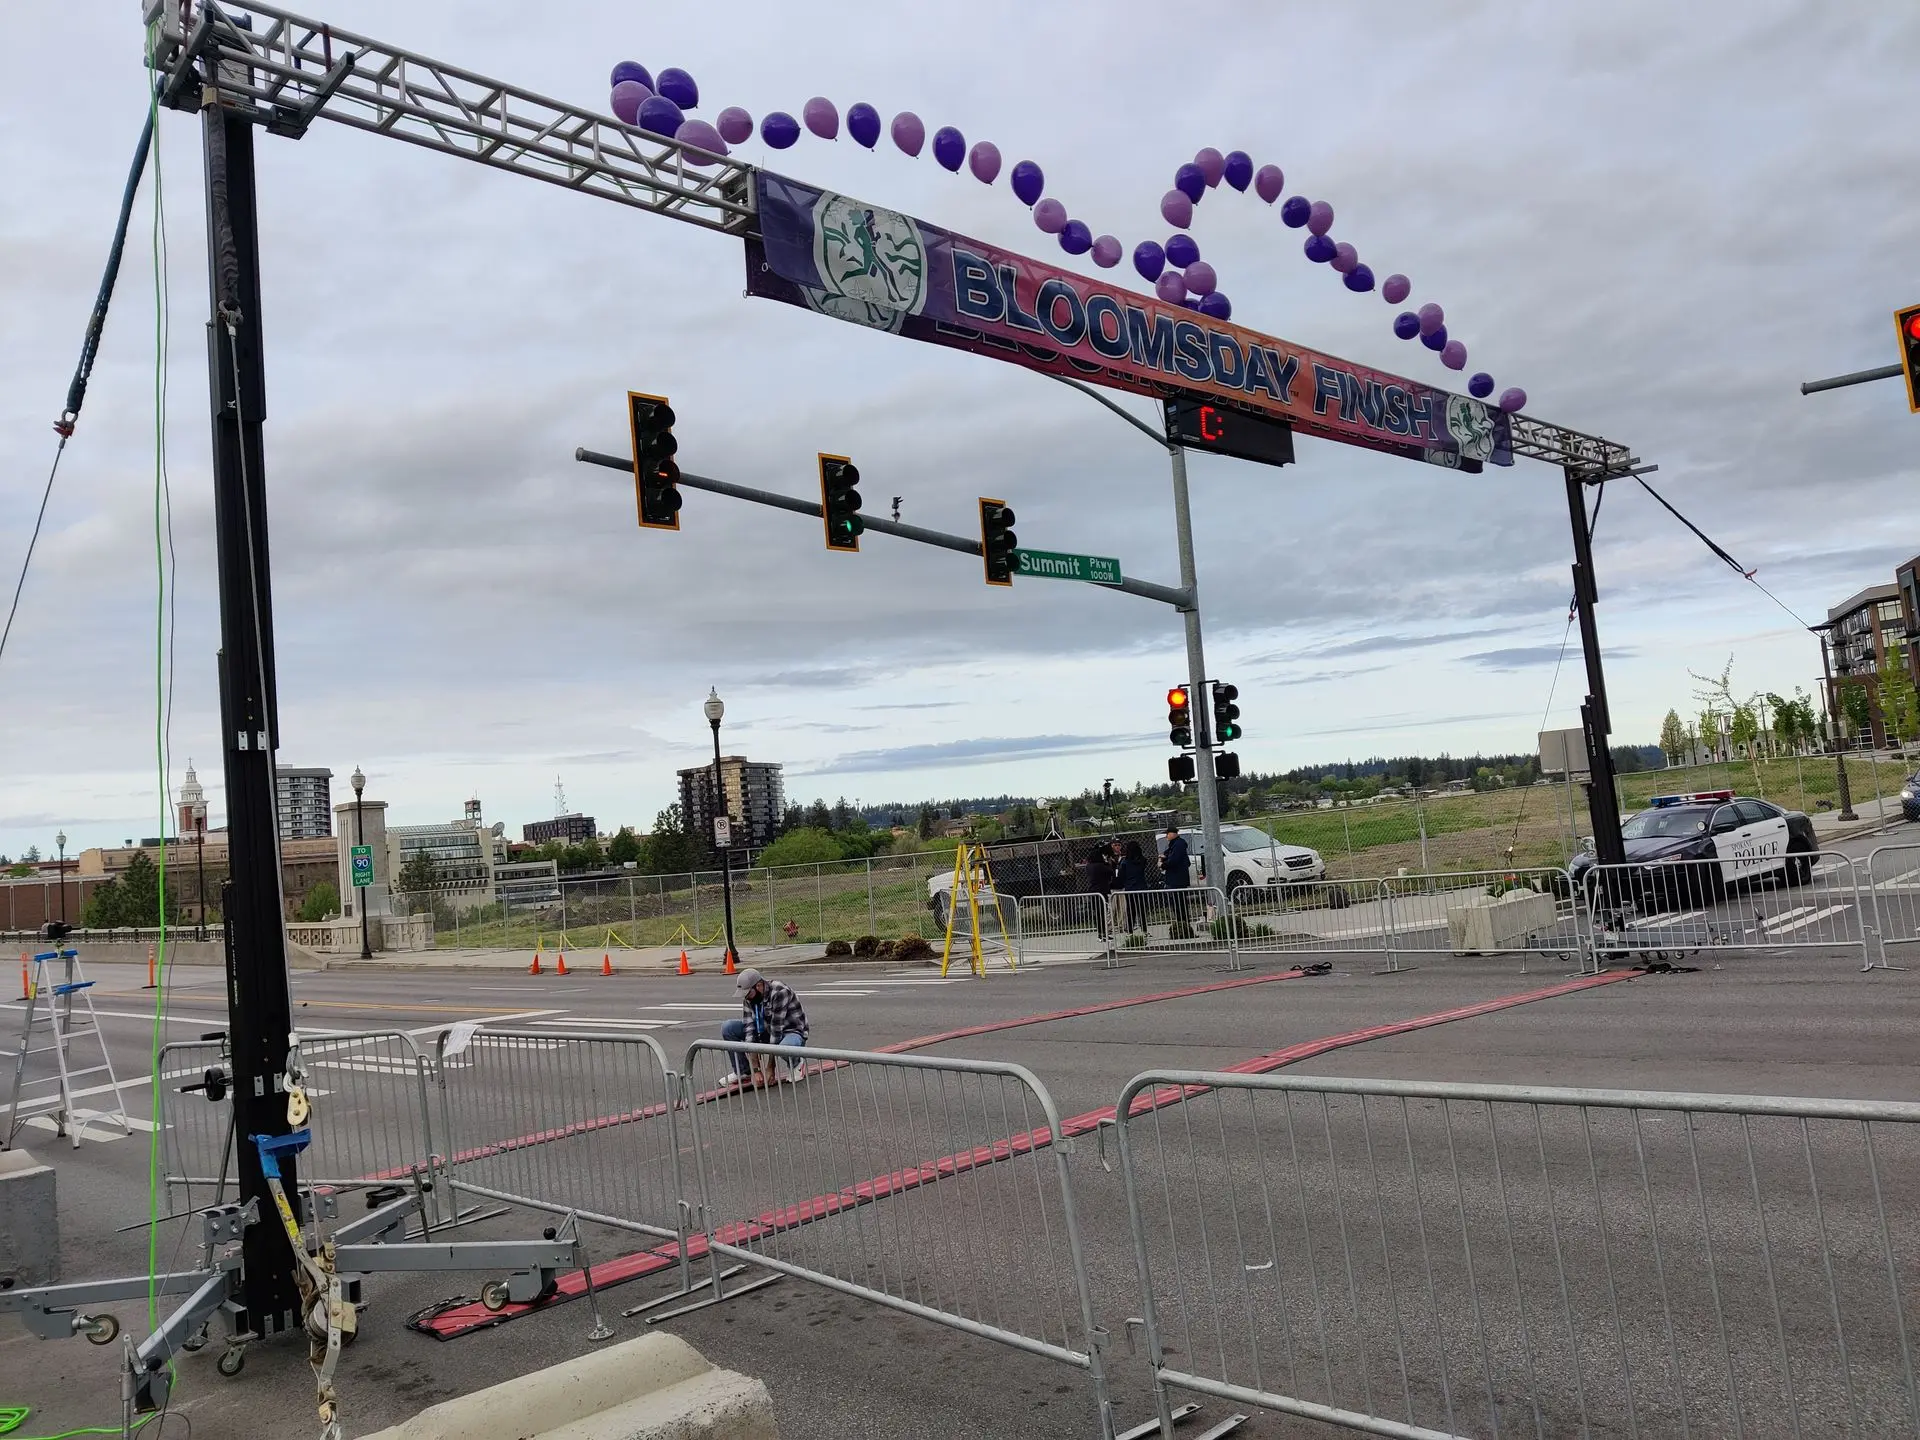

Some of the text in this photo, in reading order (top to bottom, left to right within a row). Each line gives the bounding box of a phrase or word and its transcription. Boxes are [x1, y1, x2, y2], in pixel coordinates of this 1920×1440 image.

[951, 247, 1299, 404] BLOOMSDAY
[1312, 362, 1439, 441] FINISH
[1020, 552, 1113, 576] Summit Pkwy
[356, 859, 369, 867] 90
[1734, 840, 1779, 870] POLICE
